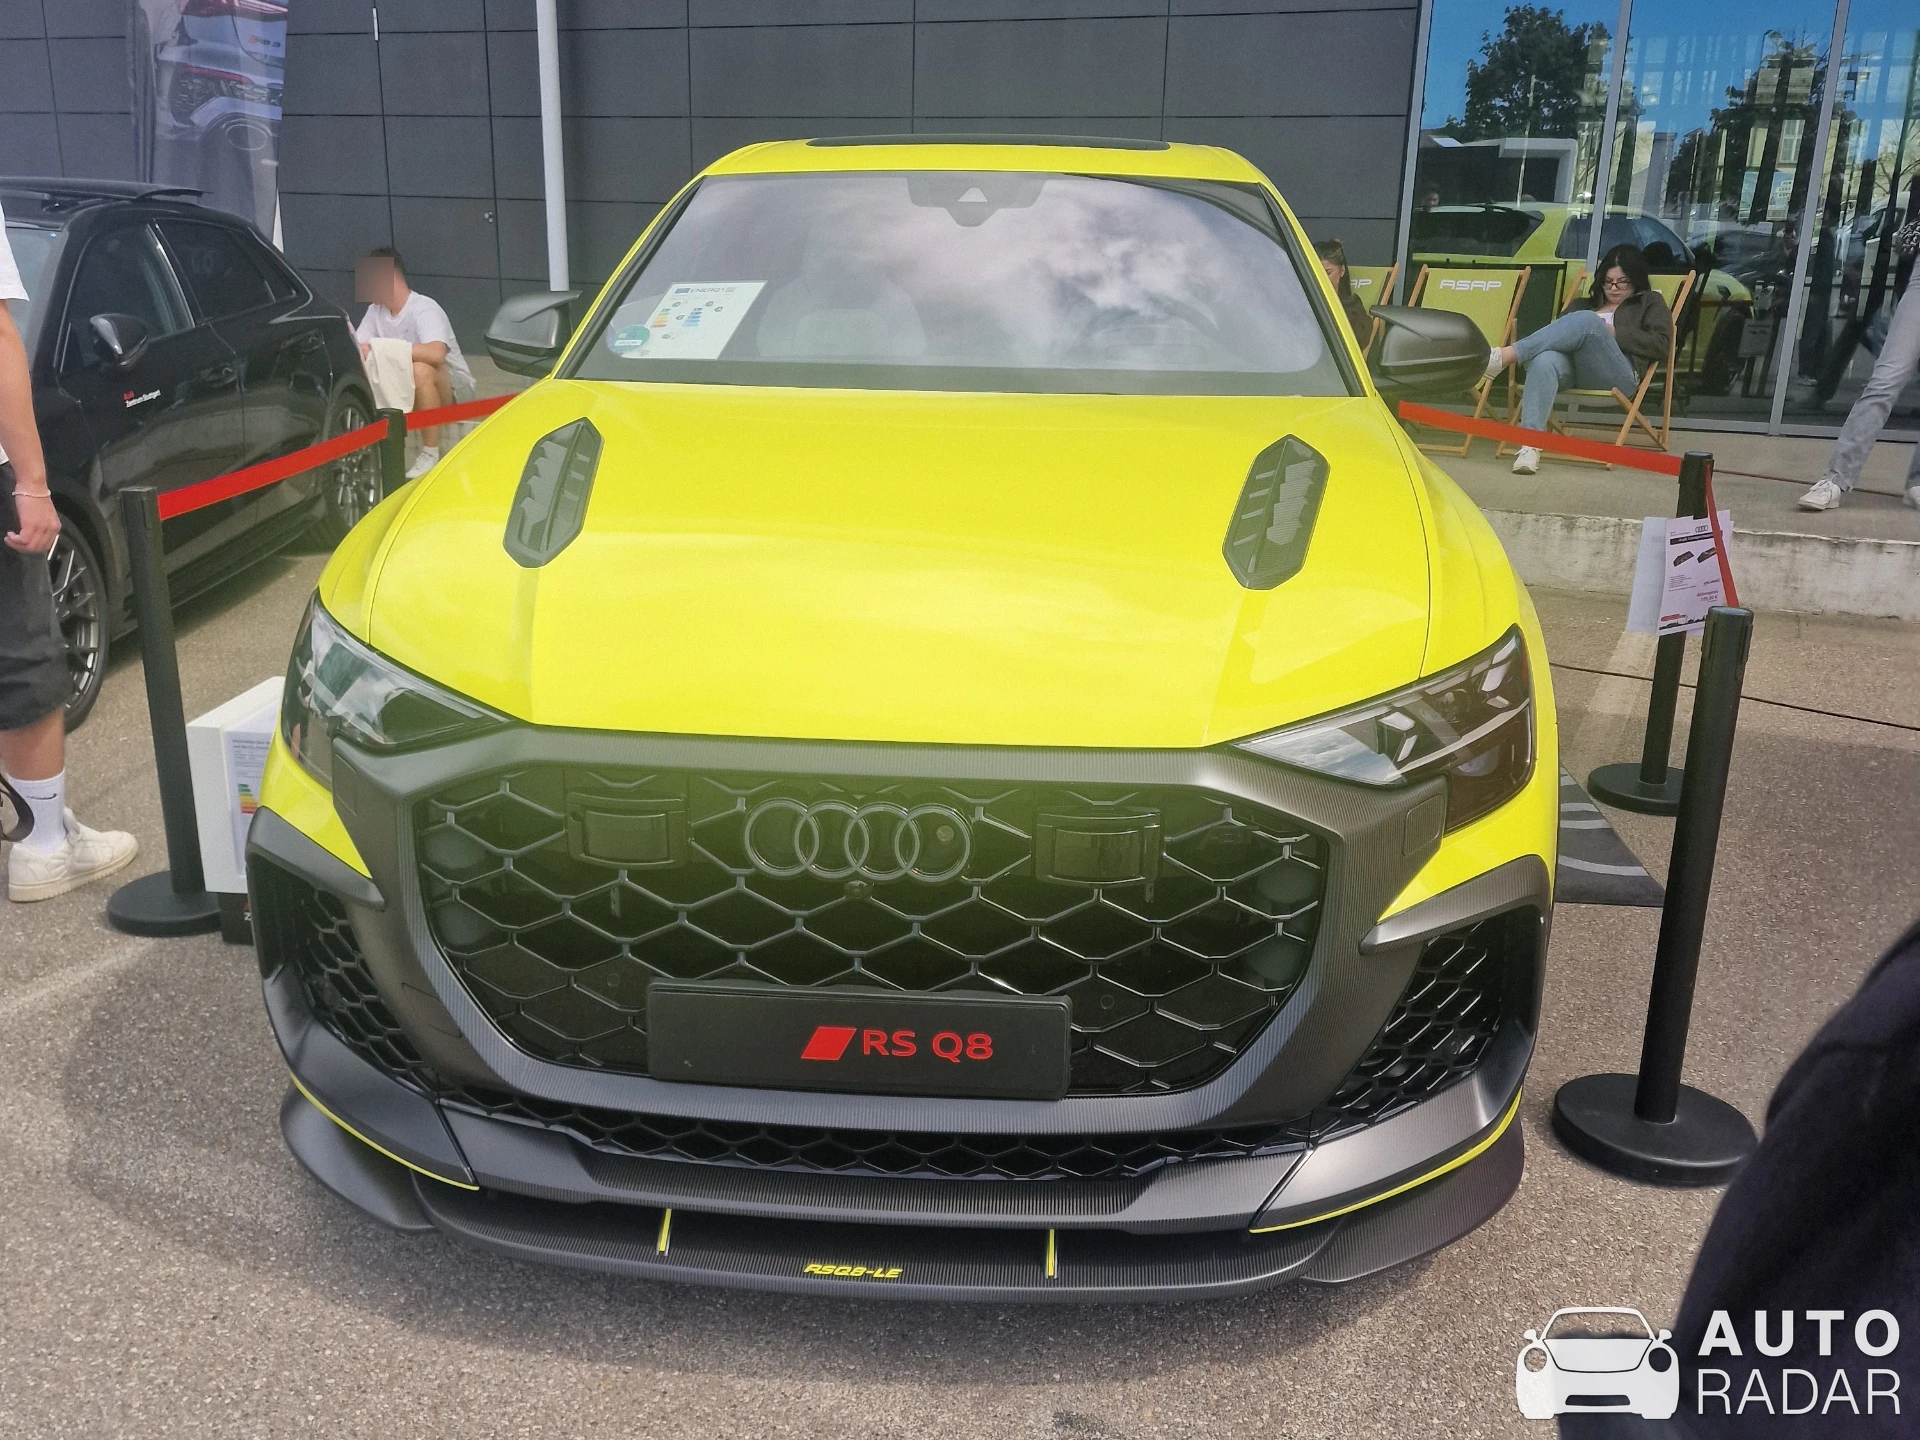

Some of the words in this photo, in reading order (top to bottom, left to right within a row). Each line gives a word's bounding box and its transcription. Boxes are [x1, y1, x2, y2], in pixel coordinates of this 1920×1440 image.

[1350, 279, 1372, 289] AP
[1439, 279, 1502, 292] ASAP
[863, 1028, 917, 1057] RS
[932, 1032, 994, 1063] Q8
[804, 1263, 903, 1279] RSQ8-LE
